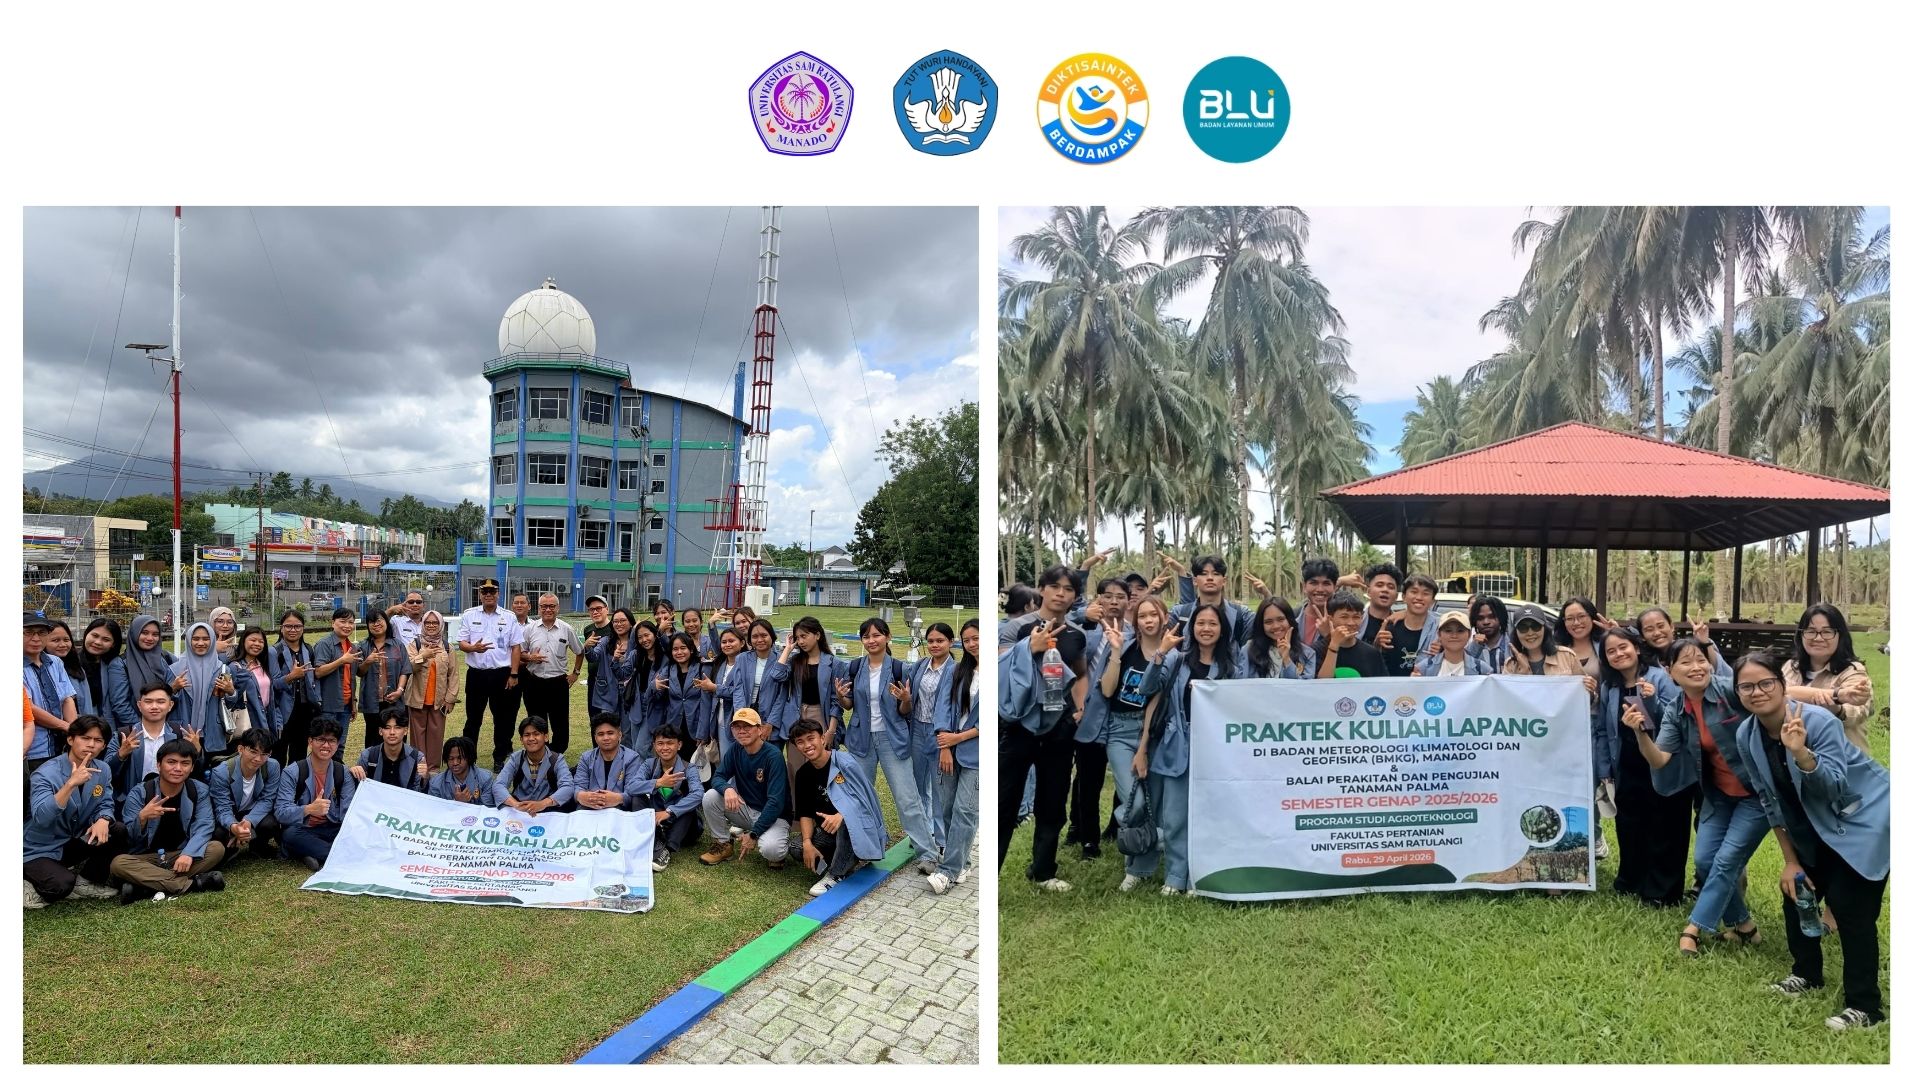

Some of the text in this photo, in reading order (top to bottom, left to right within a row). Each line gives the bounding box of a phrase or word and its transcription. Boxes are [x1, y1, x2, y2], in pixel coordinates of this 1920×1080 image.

[1225, 717, 1549, 744] PRAKTEK KULIAH LAPANG
[1253, 742, 1521, 757] DI BADAN METEOROLOGI KLIMATOLOGI DAN
[1302, 752, 1477, 766] GEOFISIKA (BMKG), MANADO
[1390, 764, 1399, 773] &
[1286, 771, 1500, 786] BALAI PERAKITAN DAN PENGUJIAN
[1340, 782, 1449, 794] TANAMAN PALMA
[1281, 791, 1498, 811] SEMESTER GENAP 2025/2026
[1299, 812, 1474, 827] PROGRAM STUDI AGROTEKNOLOGI
[374, 812, 464, 843] PRAKTEK
[466, 829, 538, 849] KULIAH
[541, 836, 621, 853] LAPANG
[1330, 828, 1444, 840] FAKULTAS PERTANIAN
[402, 836, 438, 847] BADAN
[1311, 837, 1463, 852] UNIVERSITAS SAM RATULANGI
[448, 861, 496, 869] TANAMAN
[498, 860, 535, 870] PALMA
[1345, 852, 1432, 865] Rabu, 29 April 2026
[399, 864, 464, 875] SEMESTER
[511, 872, 575, 882] 2025/2026
